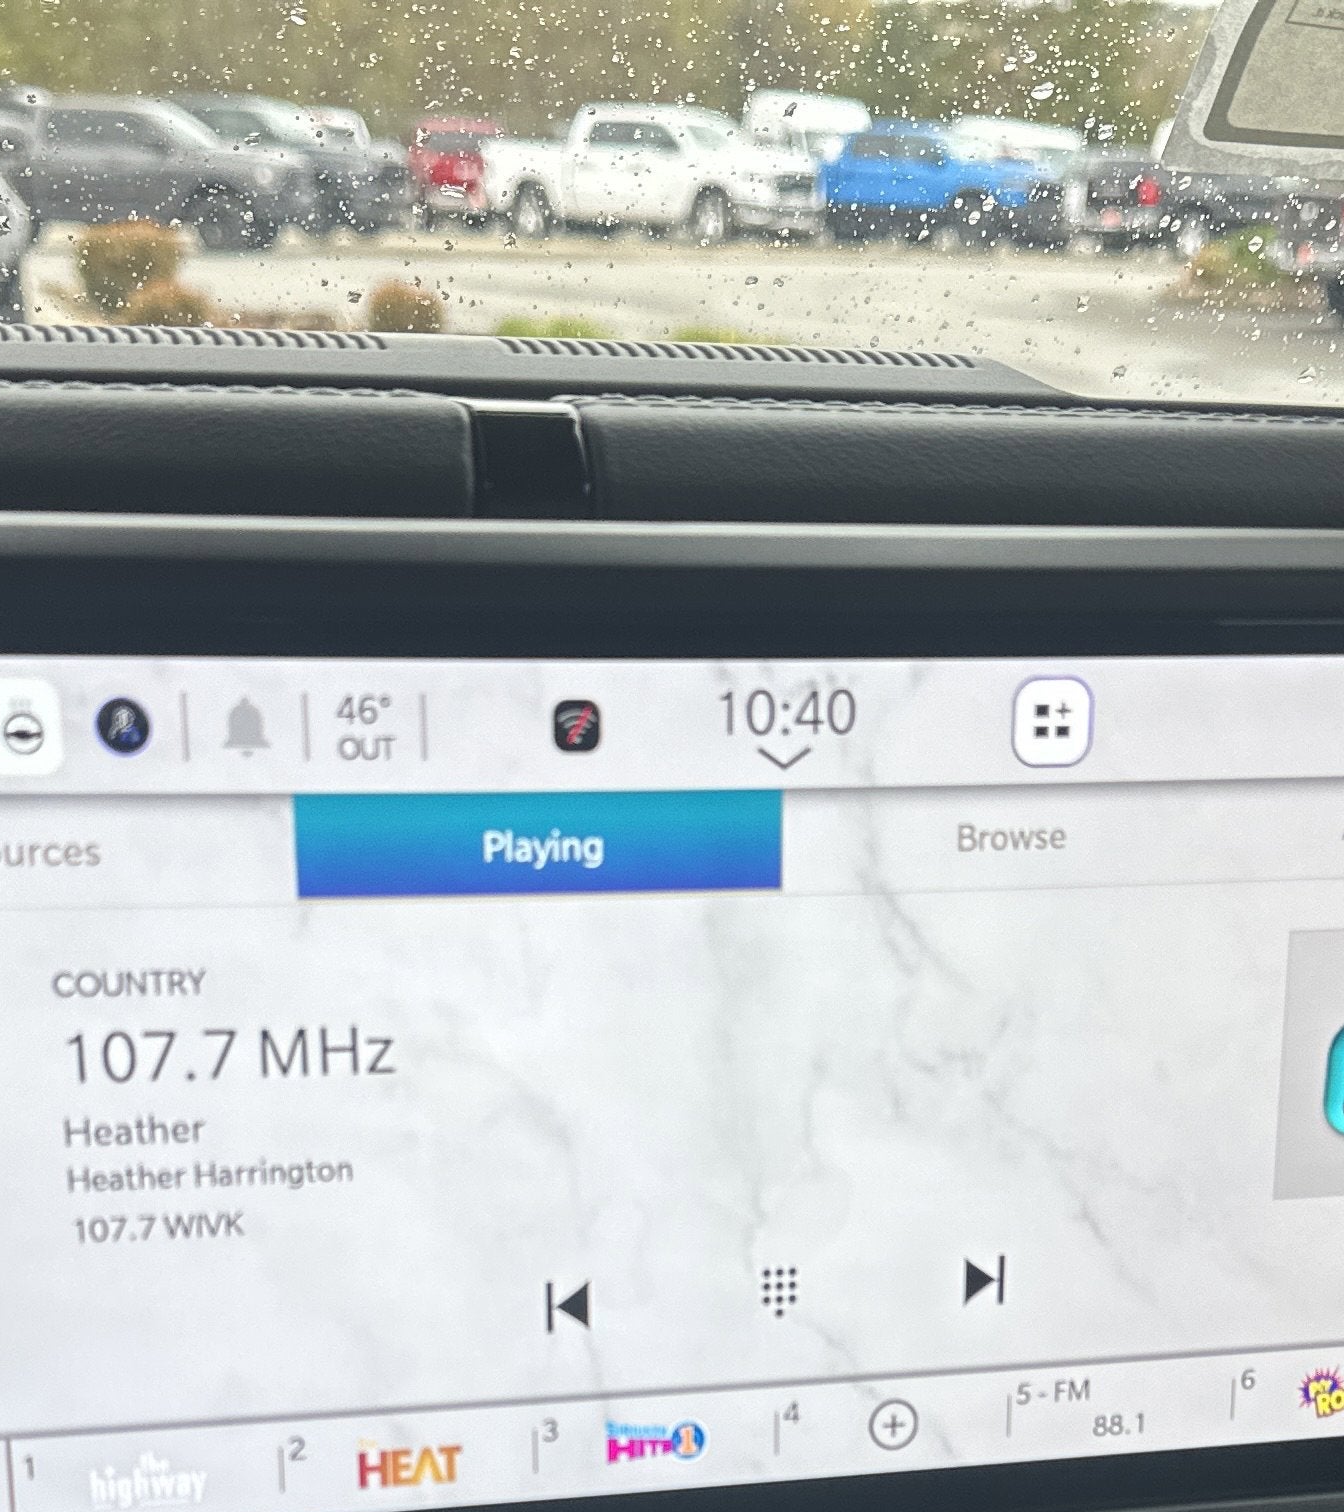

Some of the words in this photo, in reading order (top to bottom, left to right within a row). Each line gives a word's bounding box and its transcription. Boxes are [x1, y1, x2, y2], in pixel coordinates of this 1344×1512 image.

[336, 694, 393, 726] 46°
[720, 688, 858, 737] 10:40
[337, 735, 397, 762] OUT
[482, 826, 604, 870] Playing
[956, 822, 1067, 853] Browse
[51, 968, 207, 999] COUNTRY
[66, 1026, 238, 1085] 107.7
[259, 1025, 397, 1077] MHz
[62, 1115, 206, 1148] Heather
[65, 1164, 185, 1193] Heather
[193, 1156, 354, 1191] Harrington
[73, 1216, 156, 1244] 107.7
[163, 1211, 245, 1240] WIVK
[1015, 1382, 1032, 1406] 5
[1054, 1379, 1091, 1403] FM
[1240, 1368, 1256, 1391] 6
[783, 1400, 801, 1425] 4
[1092, 1412, 1145, 1437] 88.1
[541, 1416, 560, 1443] 3
[288, 1435, 308, 1462] 2
[24, 1456, 36, 1481] 1
[358, 1445, 463, 1489] HEAT
[89, 1465, 208, 1509] highway
